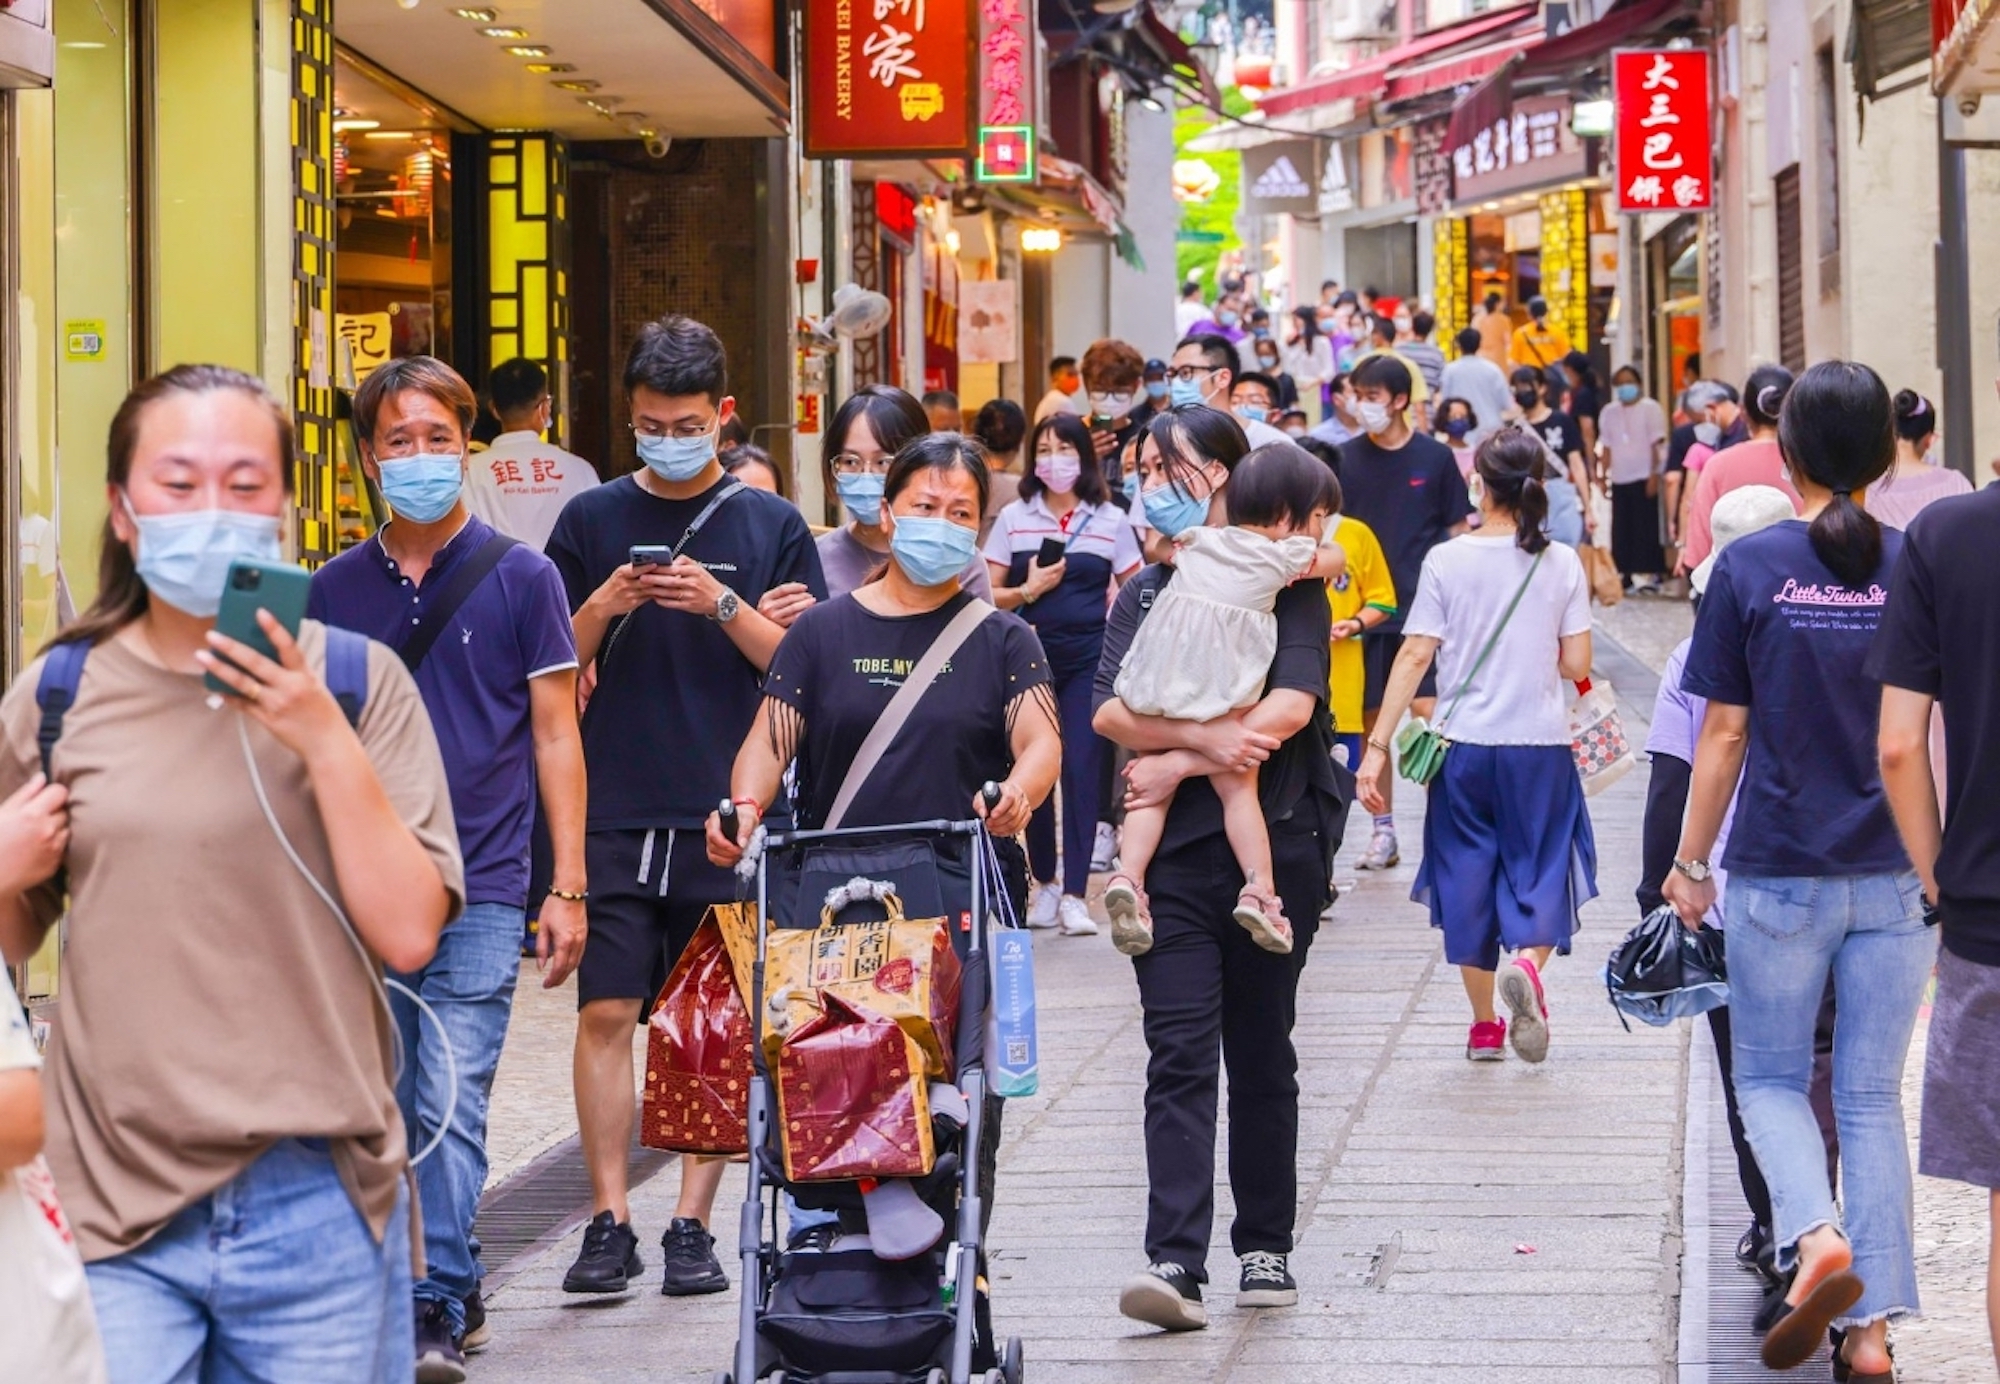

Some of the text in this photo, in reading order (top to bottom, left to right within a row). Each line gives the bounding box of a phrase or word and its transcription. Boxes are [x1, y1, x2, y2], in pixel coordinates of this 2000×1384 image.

[836, 0, 851, 121] KEI BAKERY
[1640, 54, 1684, 169] 大三巴
[1627, 174, 1704, 207] 餅家
[340, 319, 386, 359] 記
[490, 457, 564, 486] 鉅記
